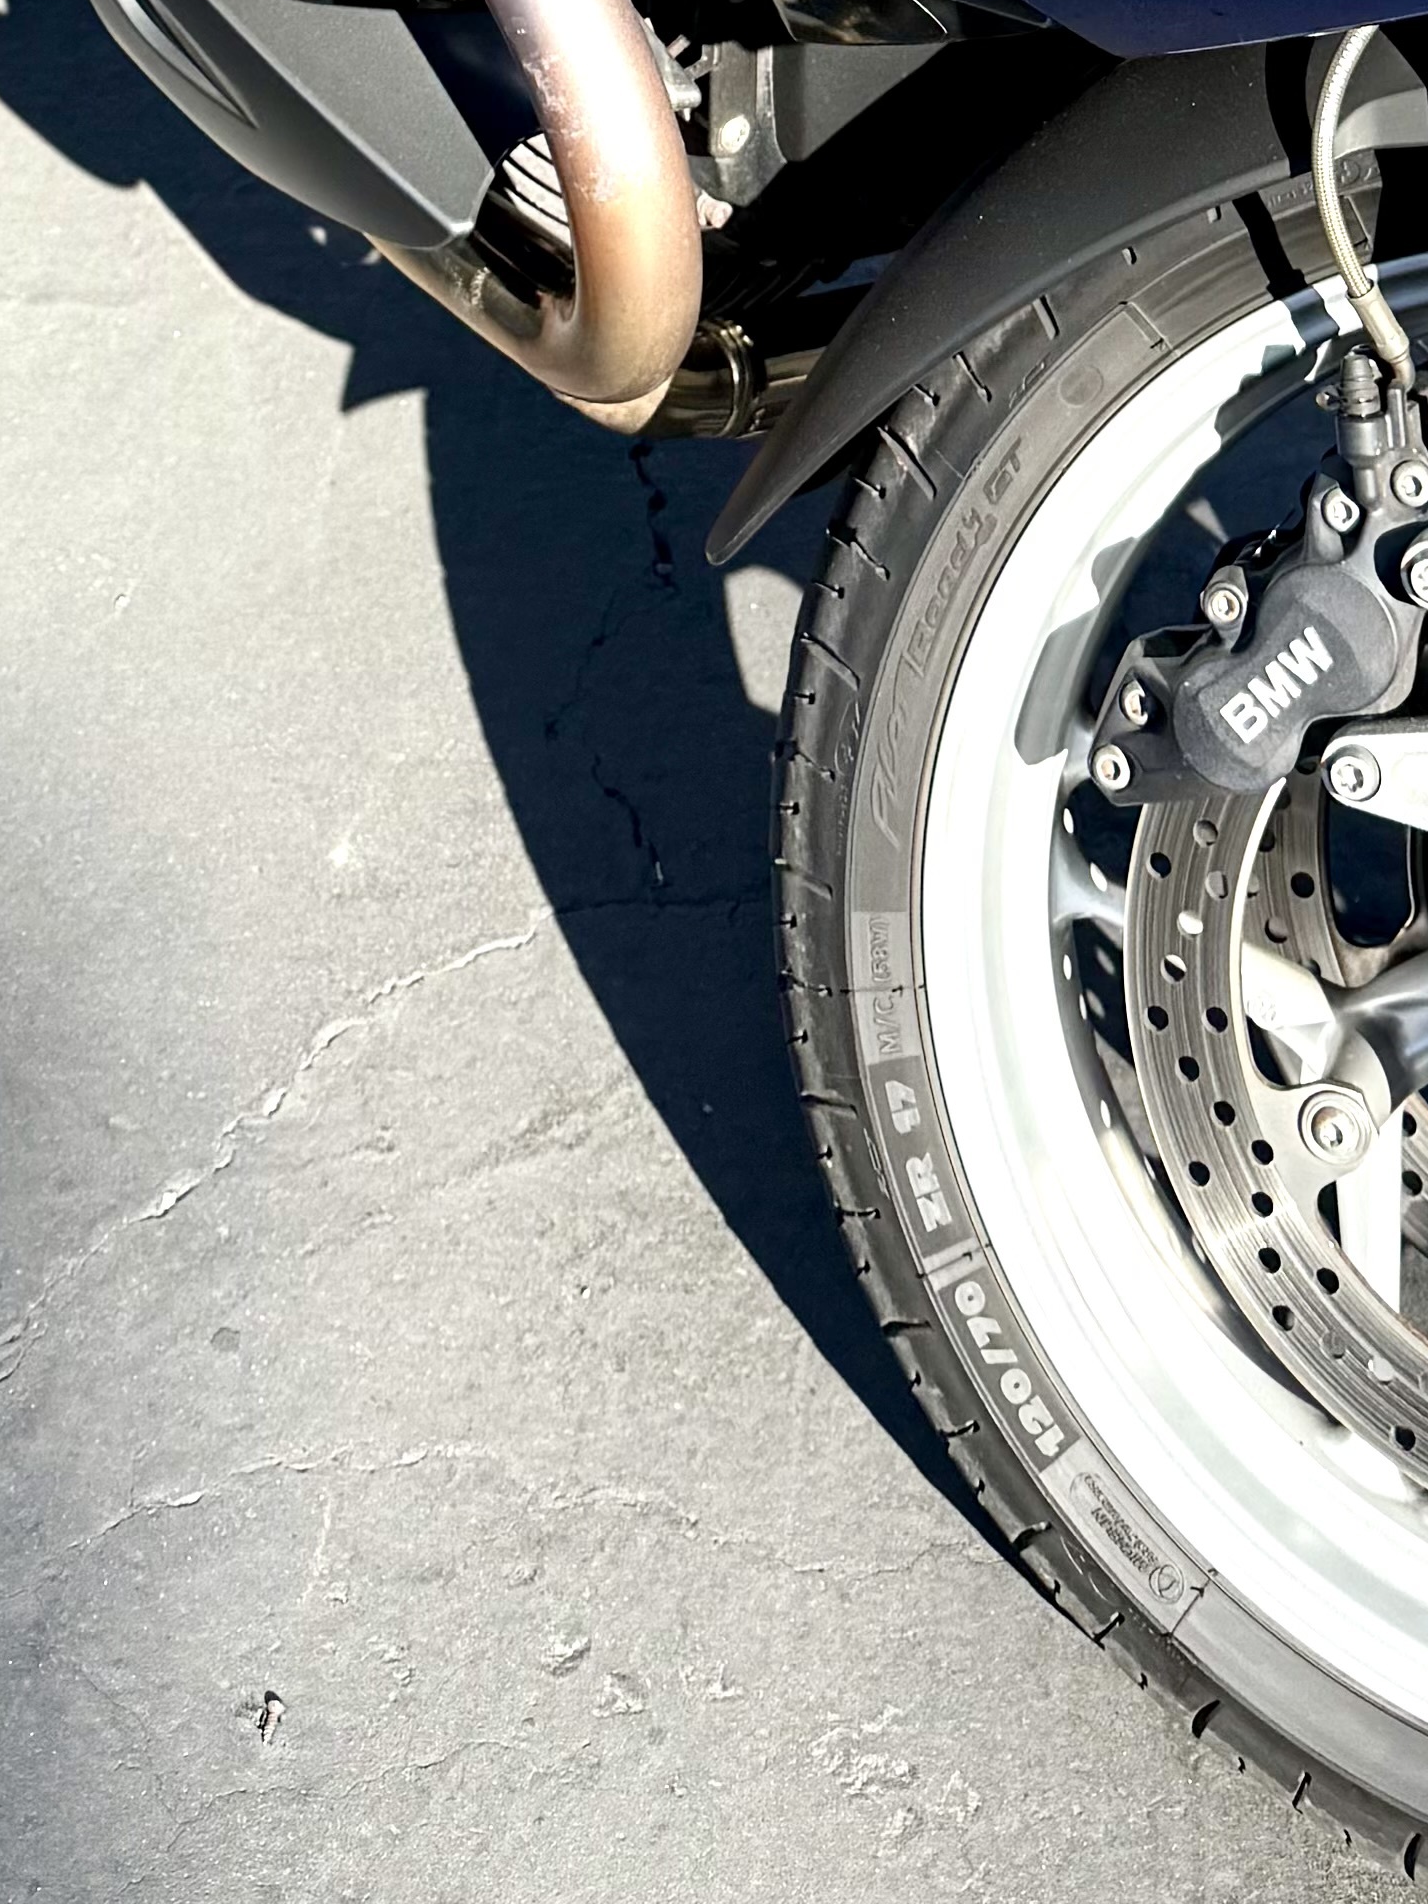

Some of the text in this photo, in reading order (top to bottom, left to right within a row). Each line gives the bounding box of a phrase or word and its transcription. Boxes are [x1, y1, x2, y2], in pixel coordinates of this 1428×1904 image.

[1219, 626, 1334, 744] BMW
[885, 1080, 921, 1135] 17
[905, 1152, 952, 1233] ZR
[954, 1280, 1065, 1457] 120/70
